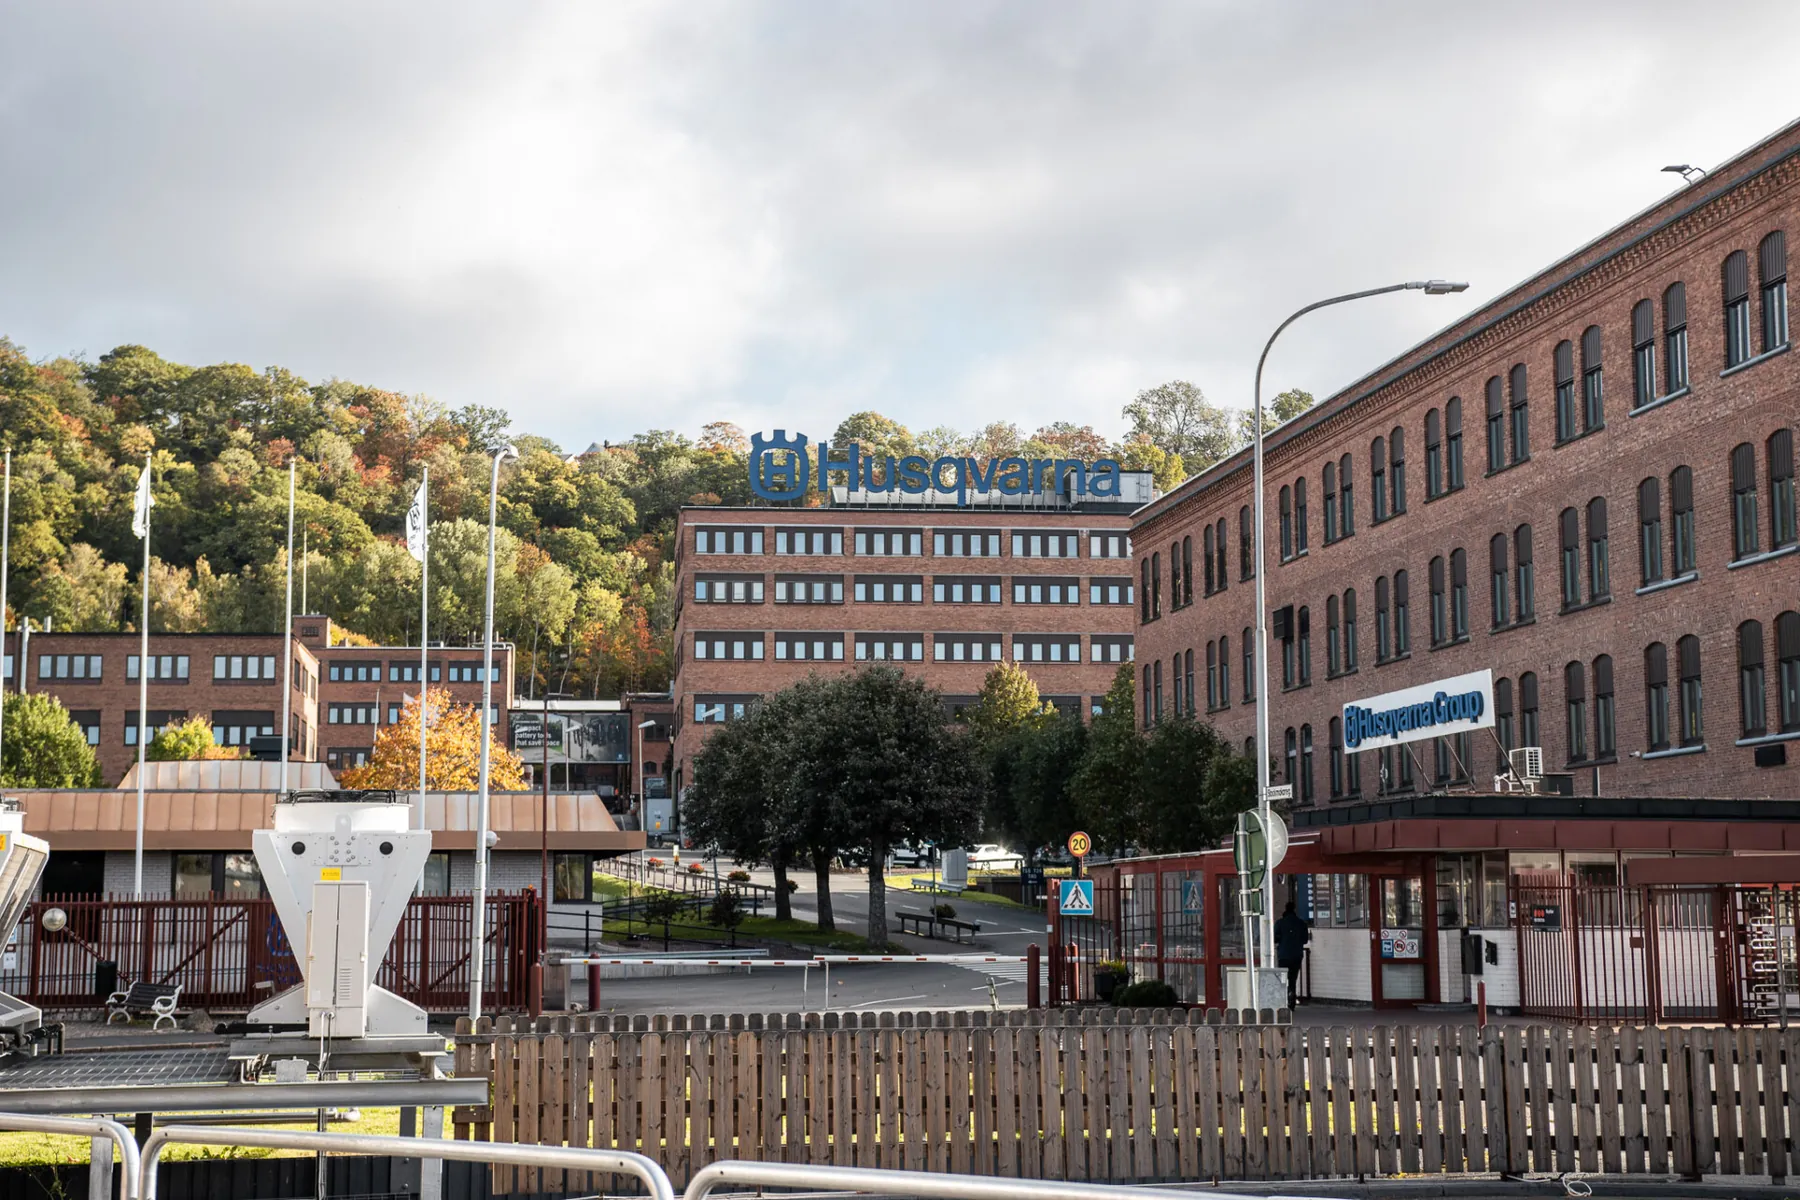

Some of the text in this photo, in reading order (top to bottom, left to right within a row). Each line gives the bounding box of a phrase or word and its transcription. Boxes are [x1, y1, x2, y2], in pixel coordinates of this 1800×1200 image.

[818, 440, 1121, 507] Husqvarna
[1358, 691, 1484, 740] Husqvarna Group
[1072, 838, 1087, 851] 20
